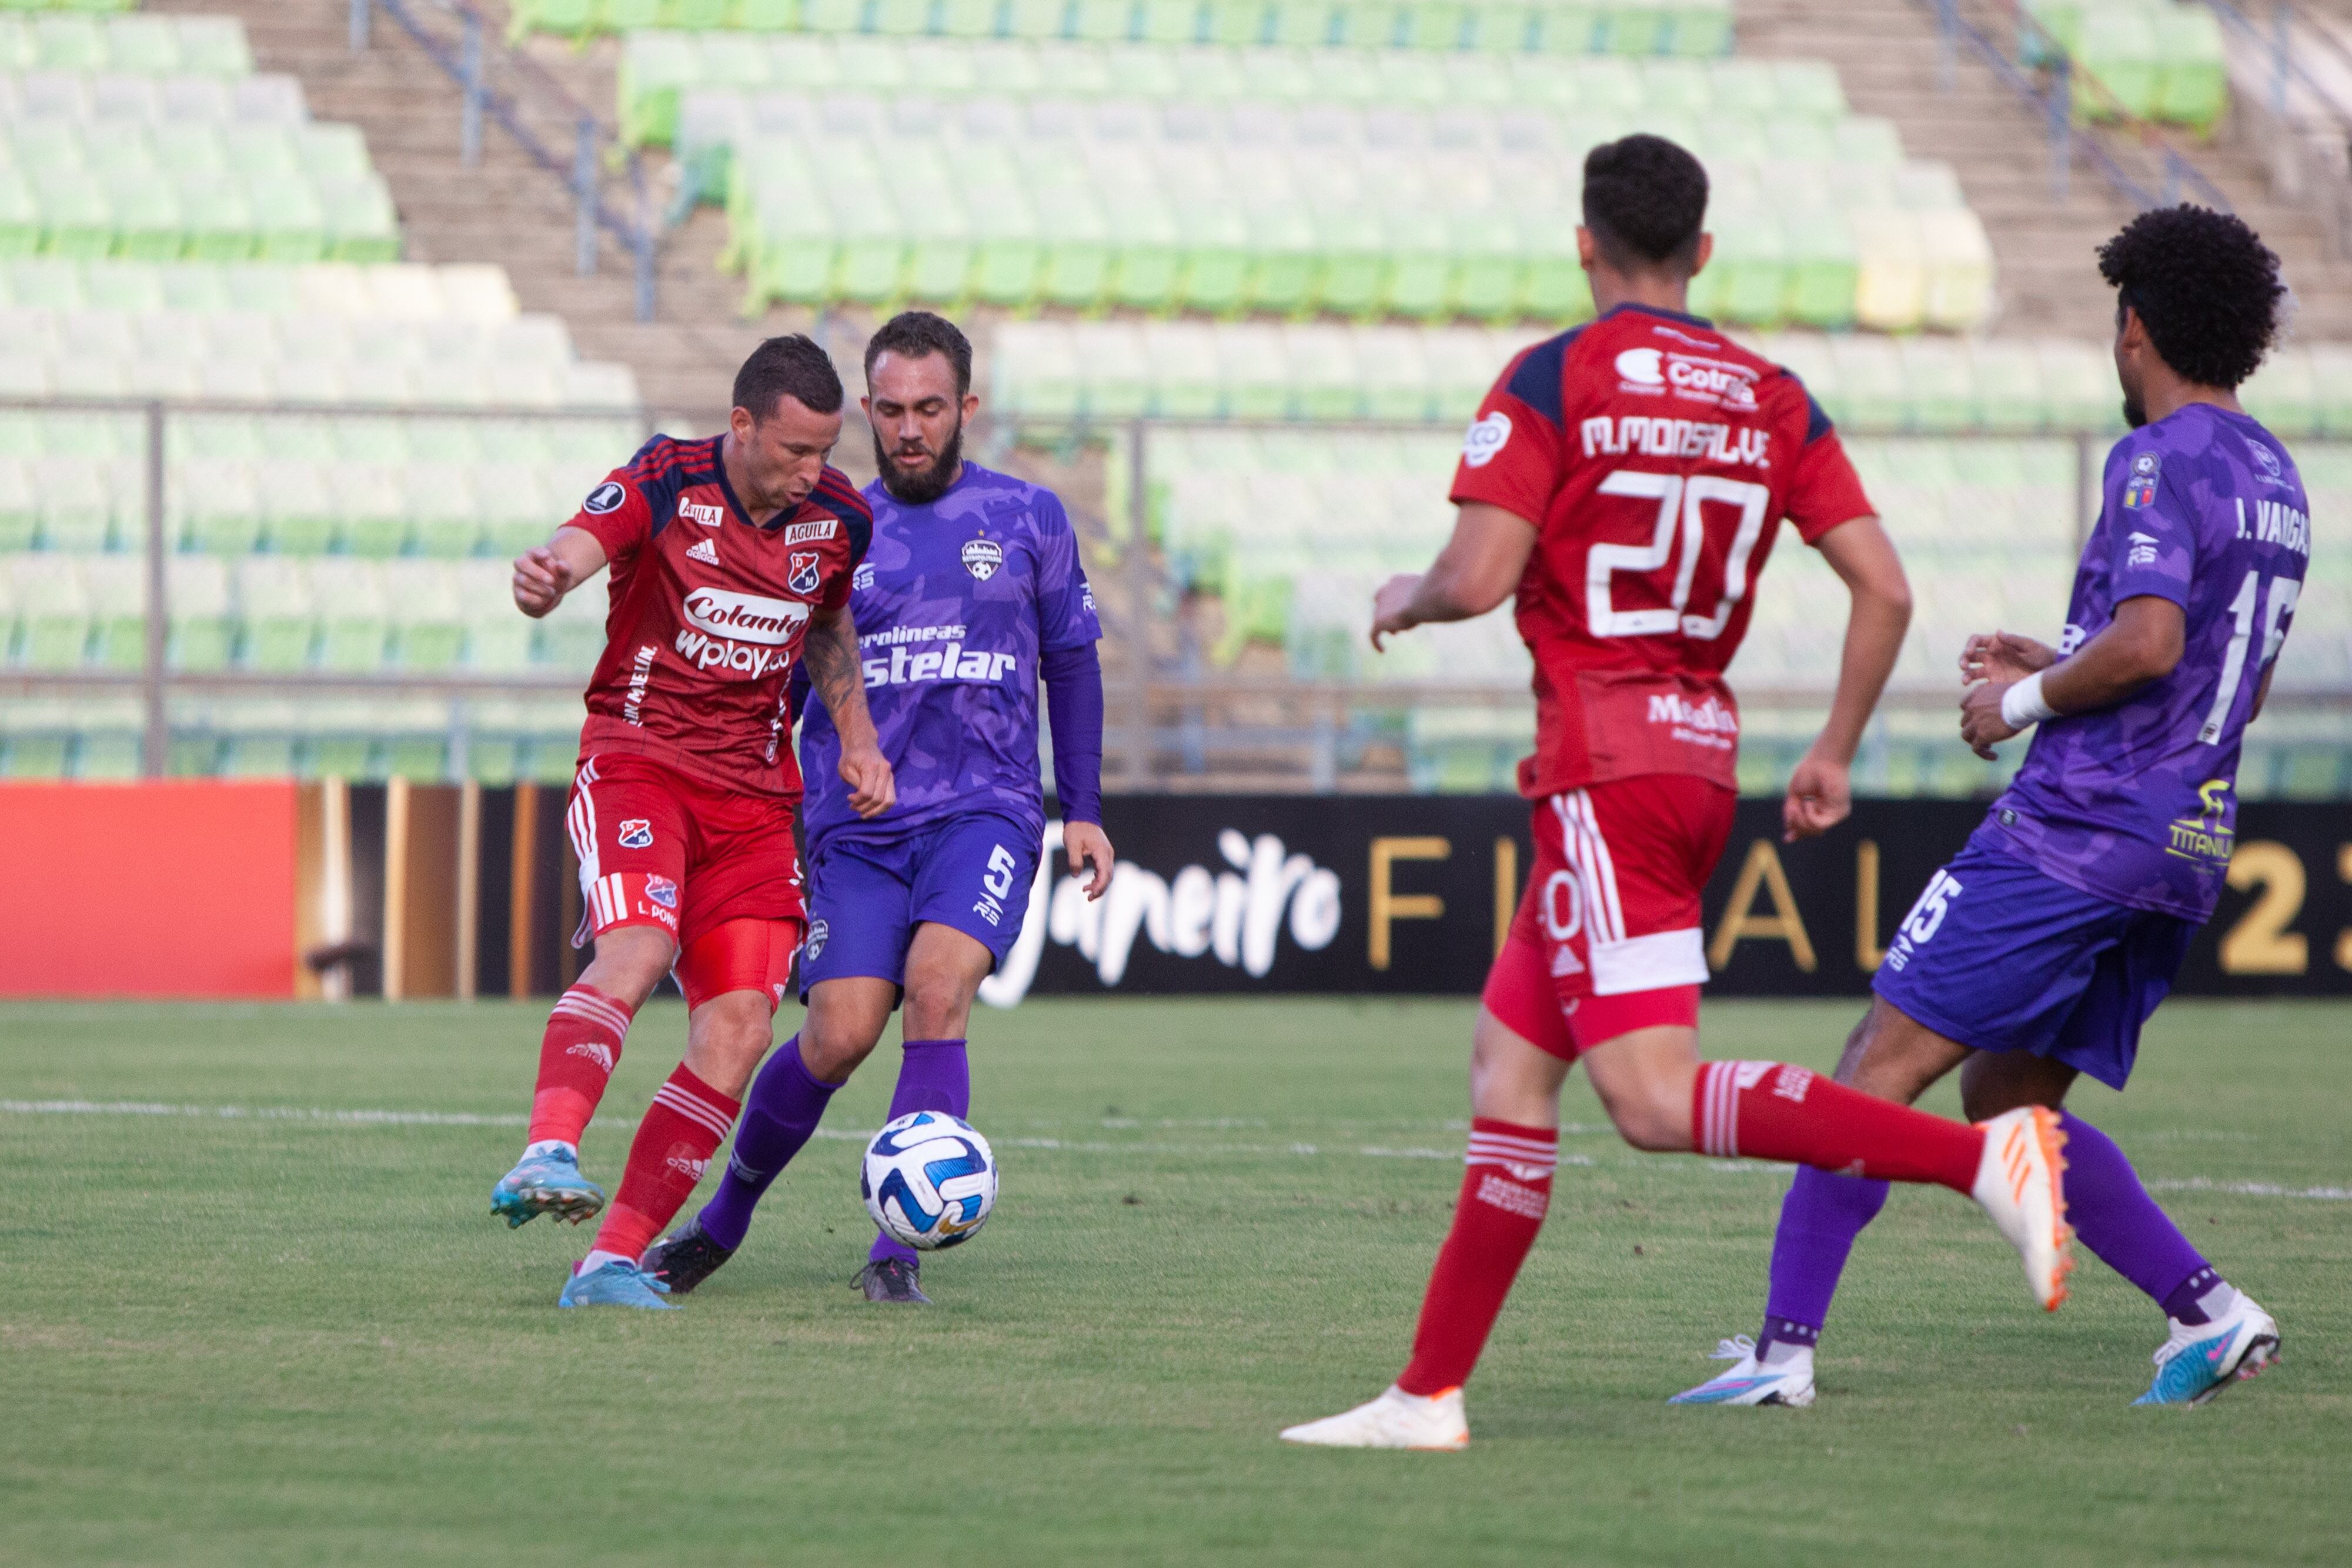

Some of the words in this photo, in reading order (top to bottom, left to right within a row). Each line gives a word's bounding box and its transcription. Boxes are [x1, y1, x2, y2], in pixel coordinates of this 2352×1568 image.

[789, 523, 831, 543] AGUILA
[1586, 470, 1769, 641] 20
[2236, 497, 2253, 540] J.
[2256, 499, 2310, 557] VARGA
[858, 624, 967, 649] rolineas
[862, 641, 1015, 688] stelar
[984, 844, 1016, 900] 5
[1368, 835, 1885, 973] FIAL
[1901, 868, 1964, 944] 15
